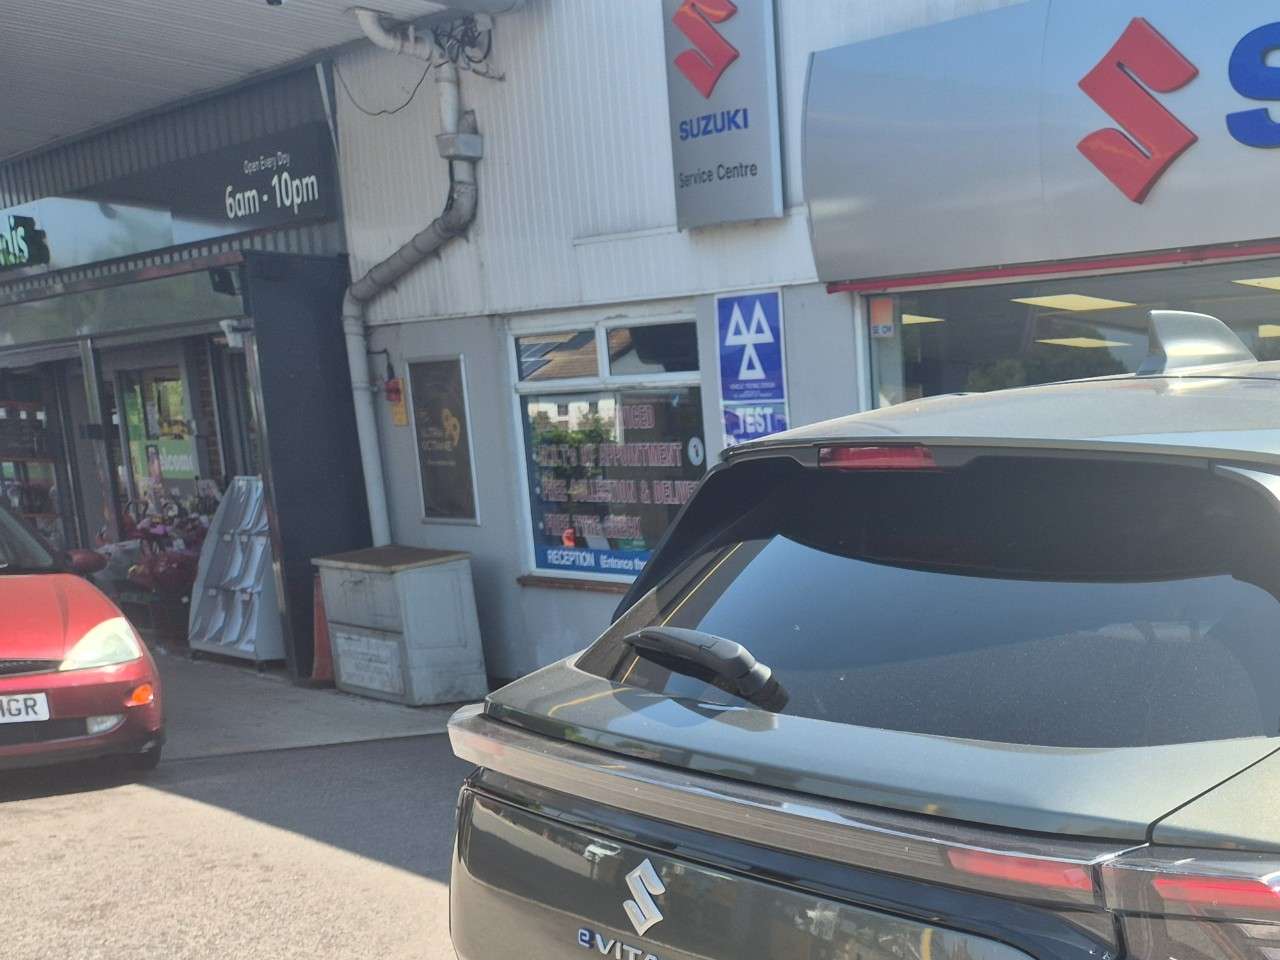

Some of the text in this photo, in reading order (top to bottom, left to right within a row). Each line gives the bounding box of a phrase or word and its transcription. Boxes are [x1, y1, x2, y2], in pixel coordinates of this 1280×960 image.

[679, 107, 749, 141] SUZUKI
[243, 159, 259, 175] Open
[260, 155, 277, 171] Every
[680, 162, 758, 188] Service Centre
[225, 185, 260, 219] 6am
[272, 171, 319, 215] 10pm
[735, 407, 774, 434] TEST
[548, 550, 595, 567] RECEPTION
